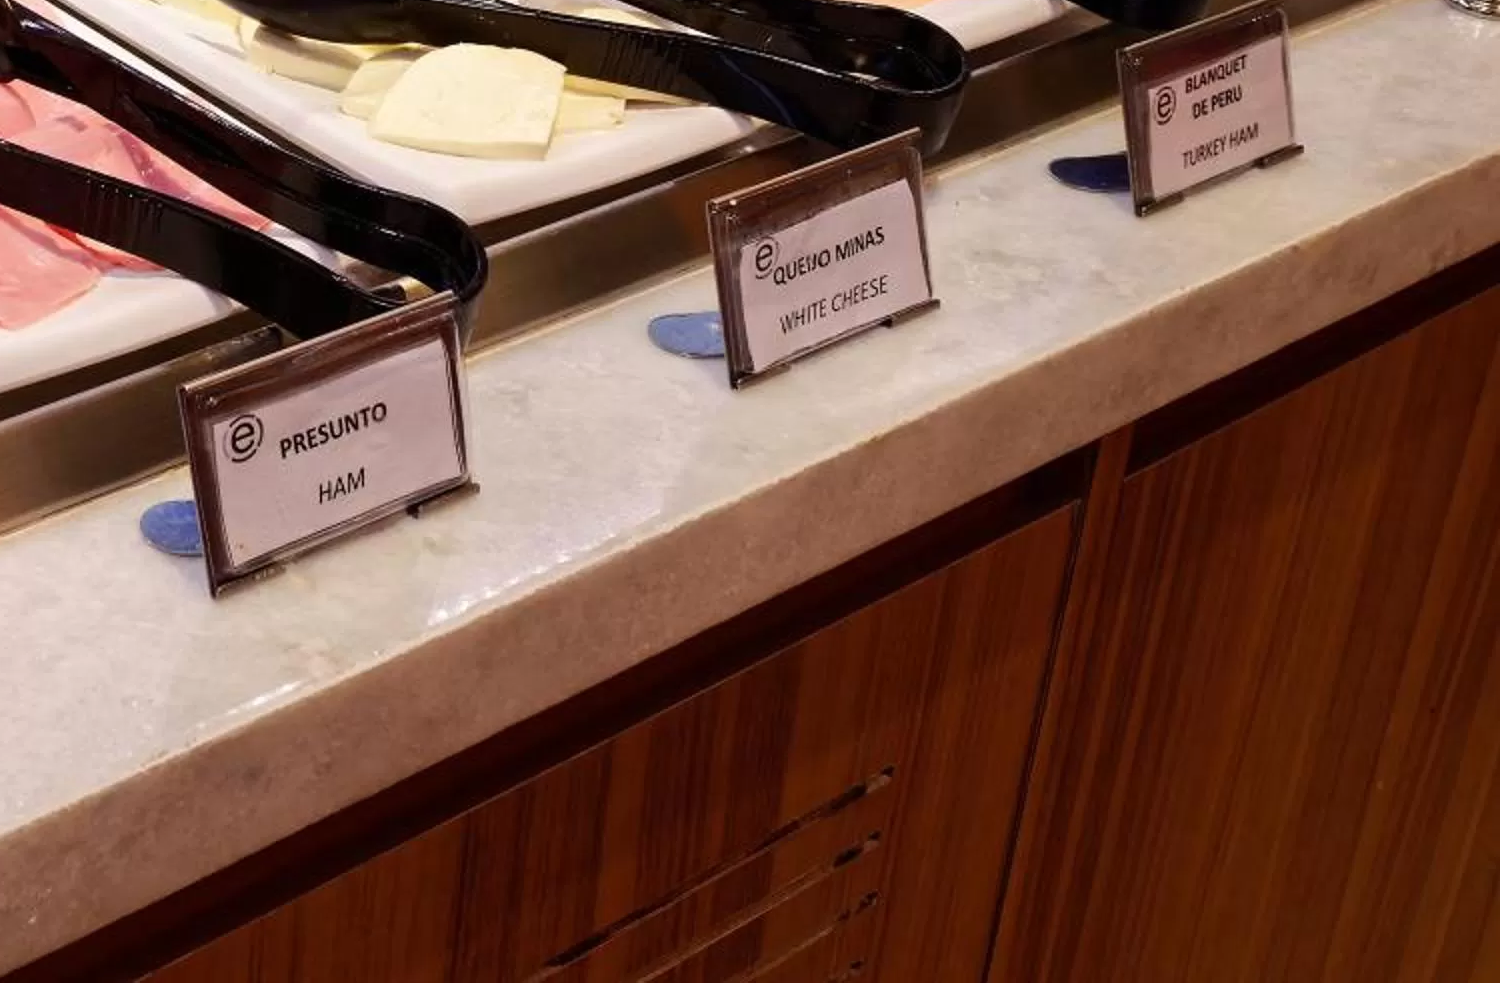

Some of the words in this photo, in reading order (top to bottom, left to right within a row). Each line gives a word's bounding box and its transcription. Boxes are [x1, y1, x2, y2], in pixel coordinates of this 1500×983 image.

[1185, 54, 1248, 94] BLANQUET
[1192, 99, 1208, 119] DE
[1211, 85, 1243, 112] PERU
[1181, 135, 1227, 169] TURKEY
[1229, 122, 1259, 150] HAM
[773, 249, 830, 286] QUEIJO
[836, 226, 885, 262] MINAS
[779, 297, 828, 334] WHITE
[831, 275, 888, 312] CHEESE
[280, 402, 387, 459] PRESUNTO
[318, 467, 366, 505] HAM
